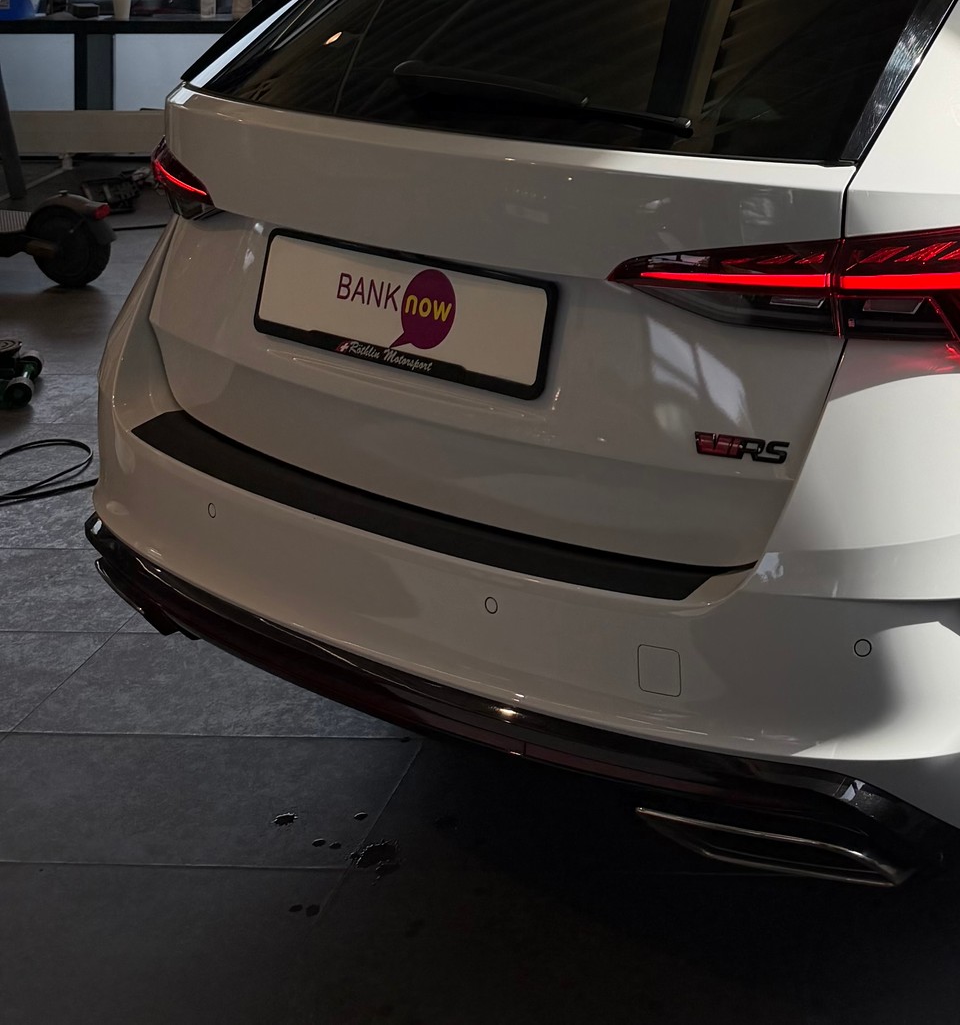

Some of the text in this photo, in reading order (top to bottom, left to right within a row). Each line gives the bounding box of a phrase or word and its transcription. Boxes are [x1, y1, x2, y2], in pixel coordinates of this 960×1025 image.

[337, 272, 453, 322] BANK now
[348, 341, 434, 372] Röthlin Motorsport
